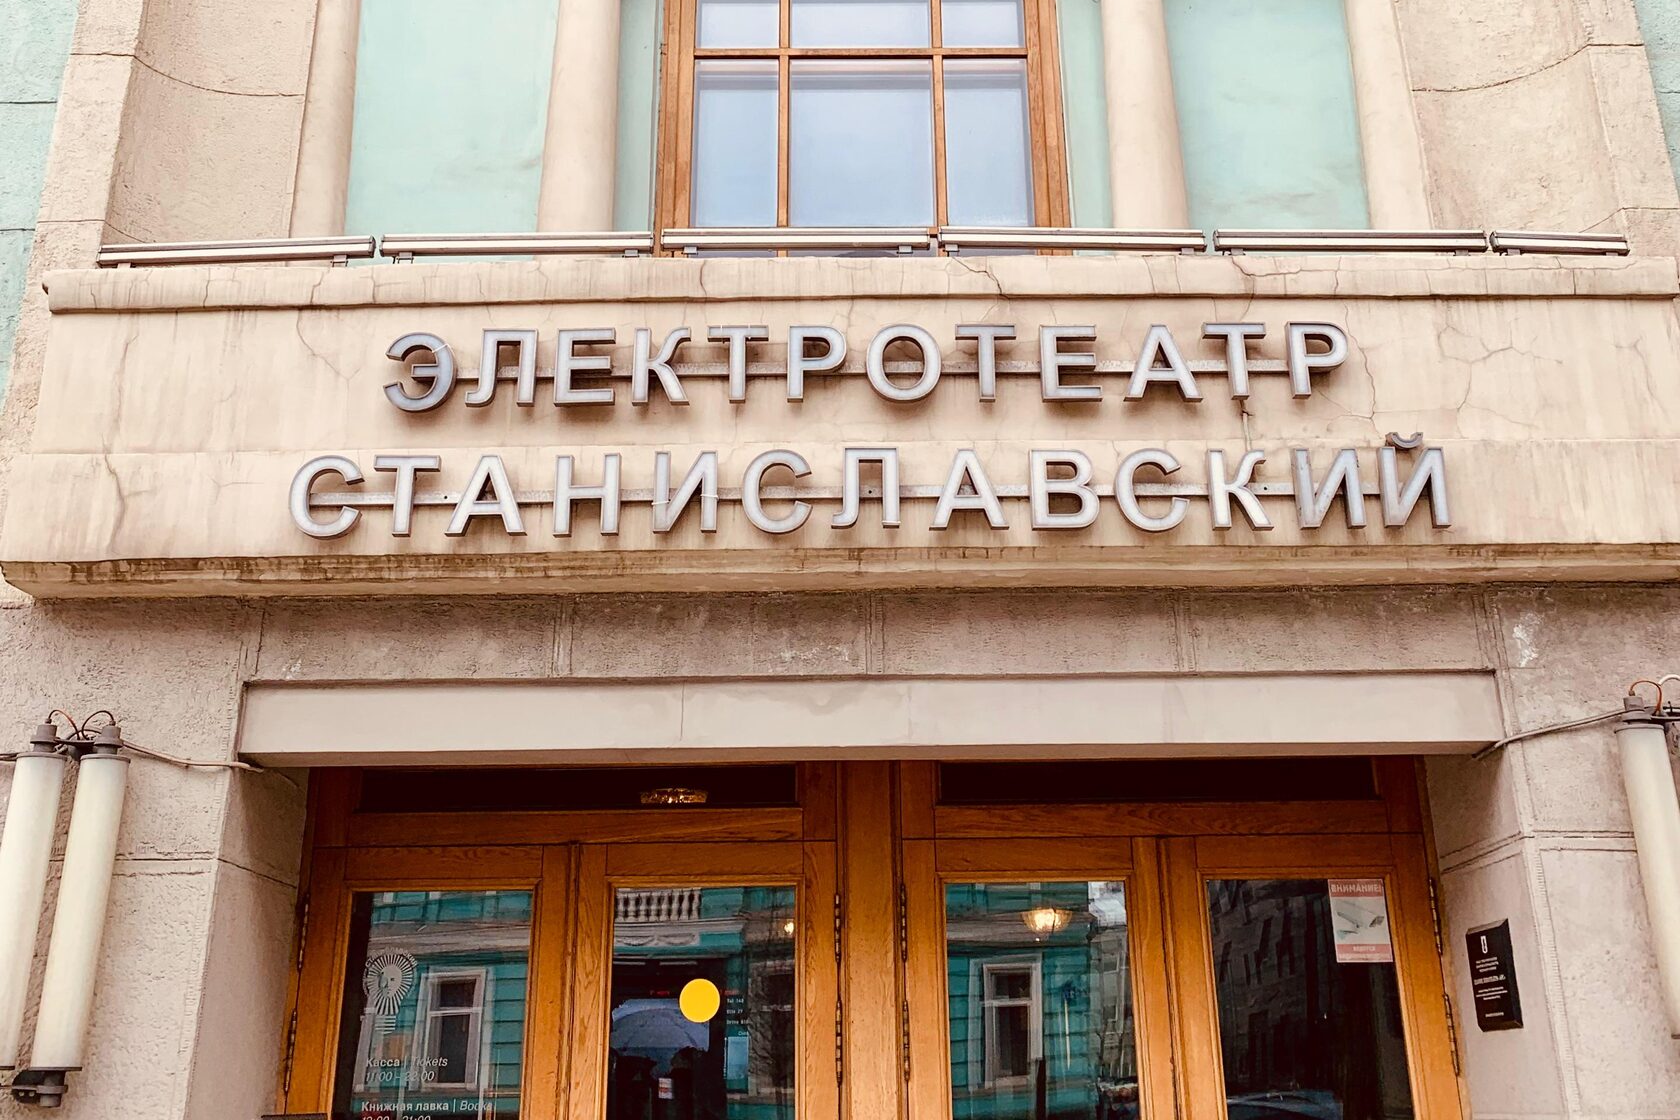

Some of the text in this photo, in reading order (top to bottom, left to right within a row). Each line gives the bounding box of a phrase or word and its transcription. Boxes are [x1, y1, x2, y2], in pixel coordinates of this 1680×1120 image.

[384, 322, 1349, 412] ЭЛЕКТРОТЕАТР
[288, 431, 1452, 539] СТАНИСЛАВСКИЙ
[366, 1057, 400, 1068] Касса
[361, 1101, 413, 1112] Книжная
[415, 1101, 449, 1111] лавка
